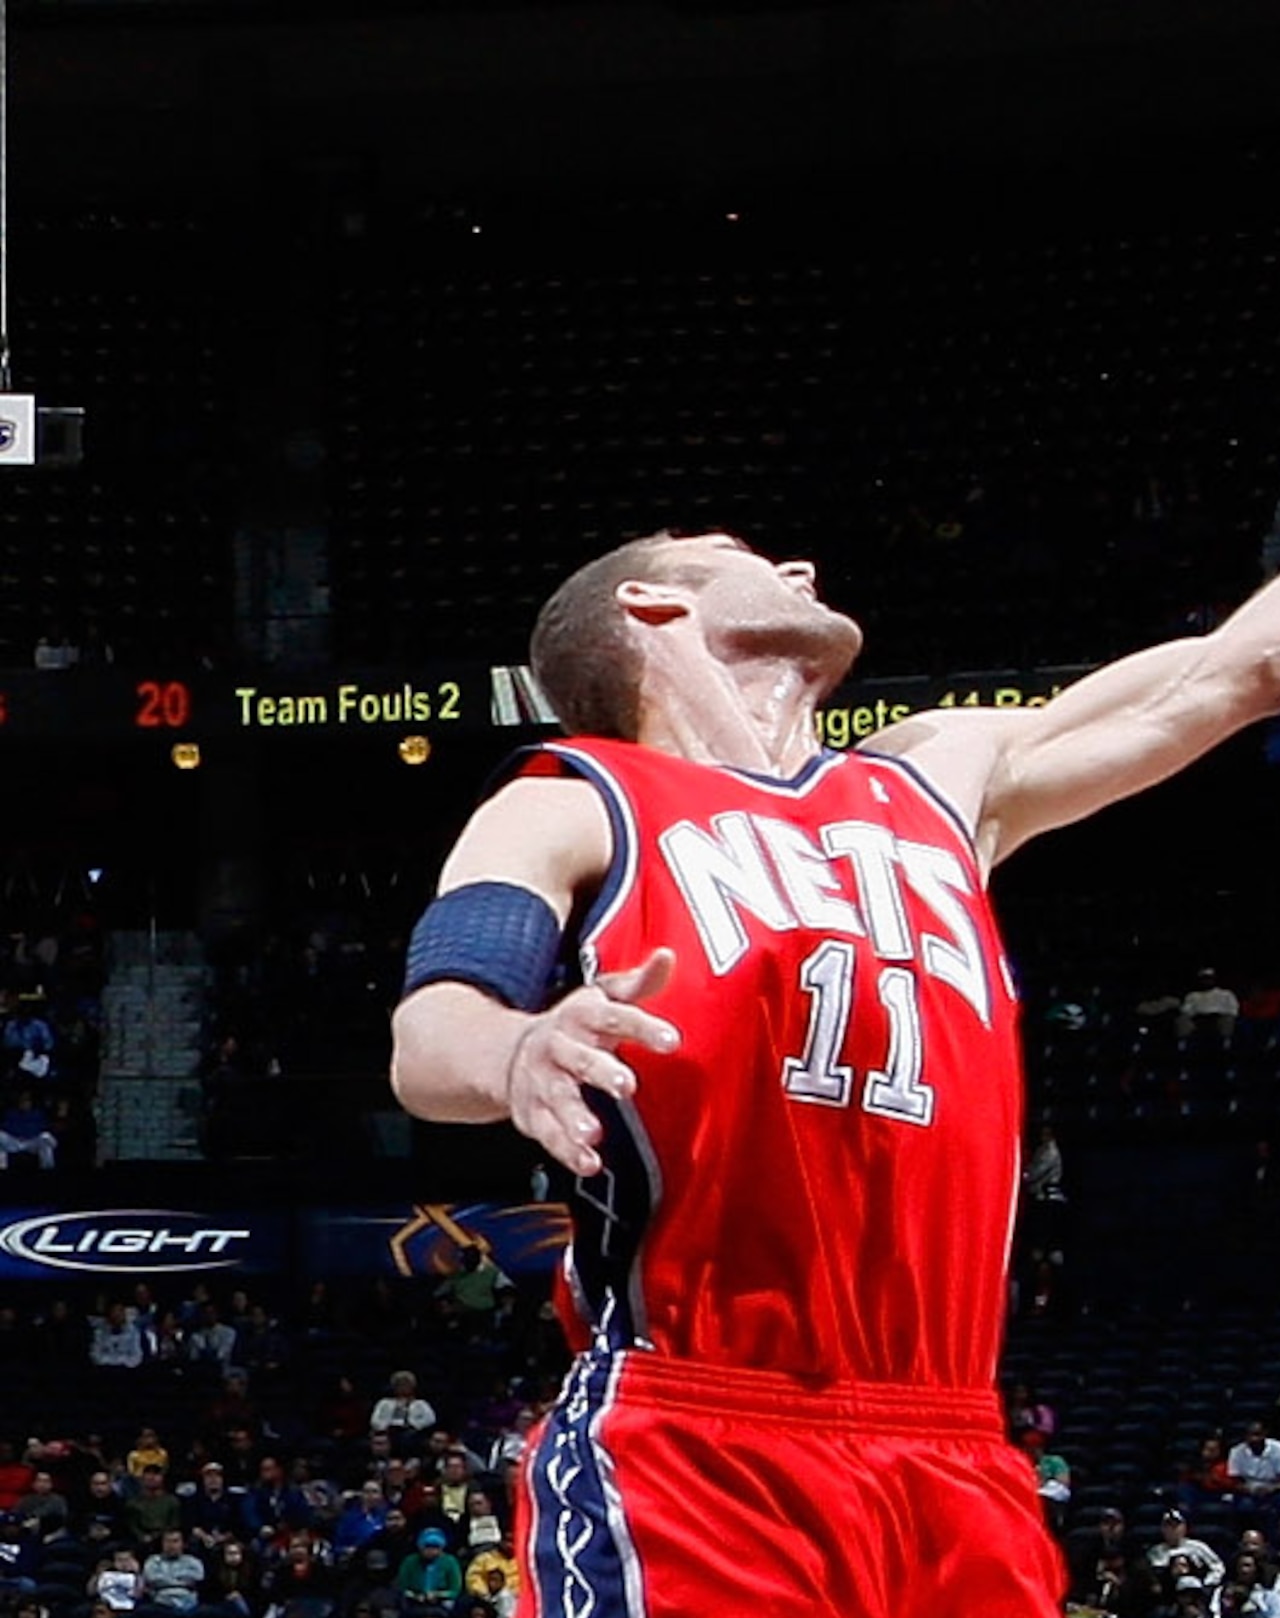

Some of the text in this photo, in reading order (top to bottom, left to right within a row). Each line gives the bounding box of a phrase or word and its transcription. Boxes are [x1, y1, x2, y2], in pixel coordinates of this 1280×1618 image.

[135, 681, 189, 727] 20
[235, 681, 461, 726] Team Fouls 2
[657, 810, 993, 1030] NETS
[781, 938, 935, 1127] 11
[33, 1226, 250, 1253] LIGHT
